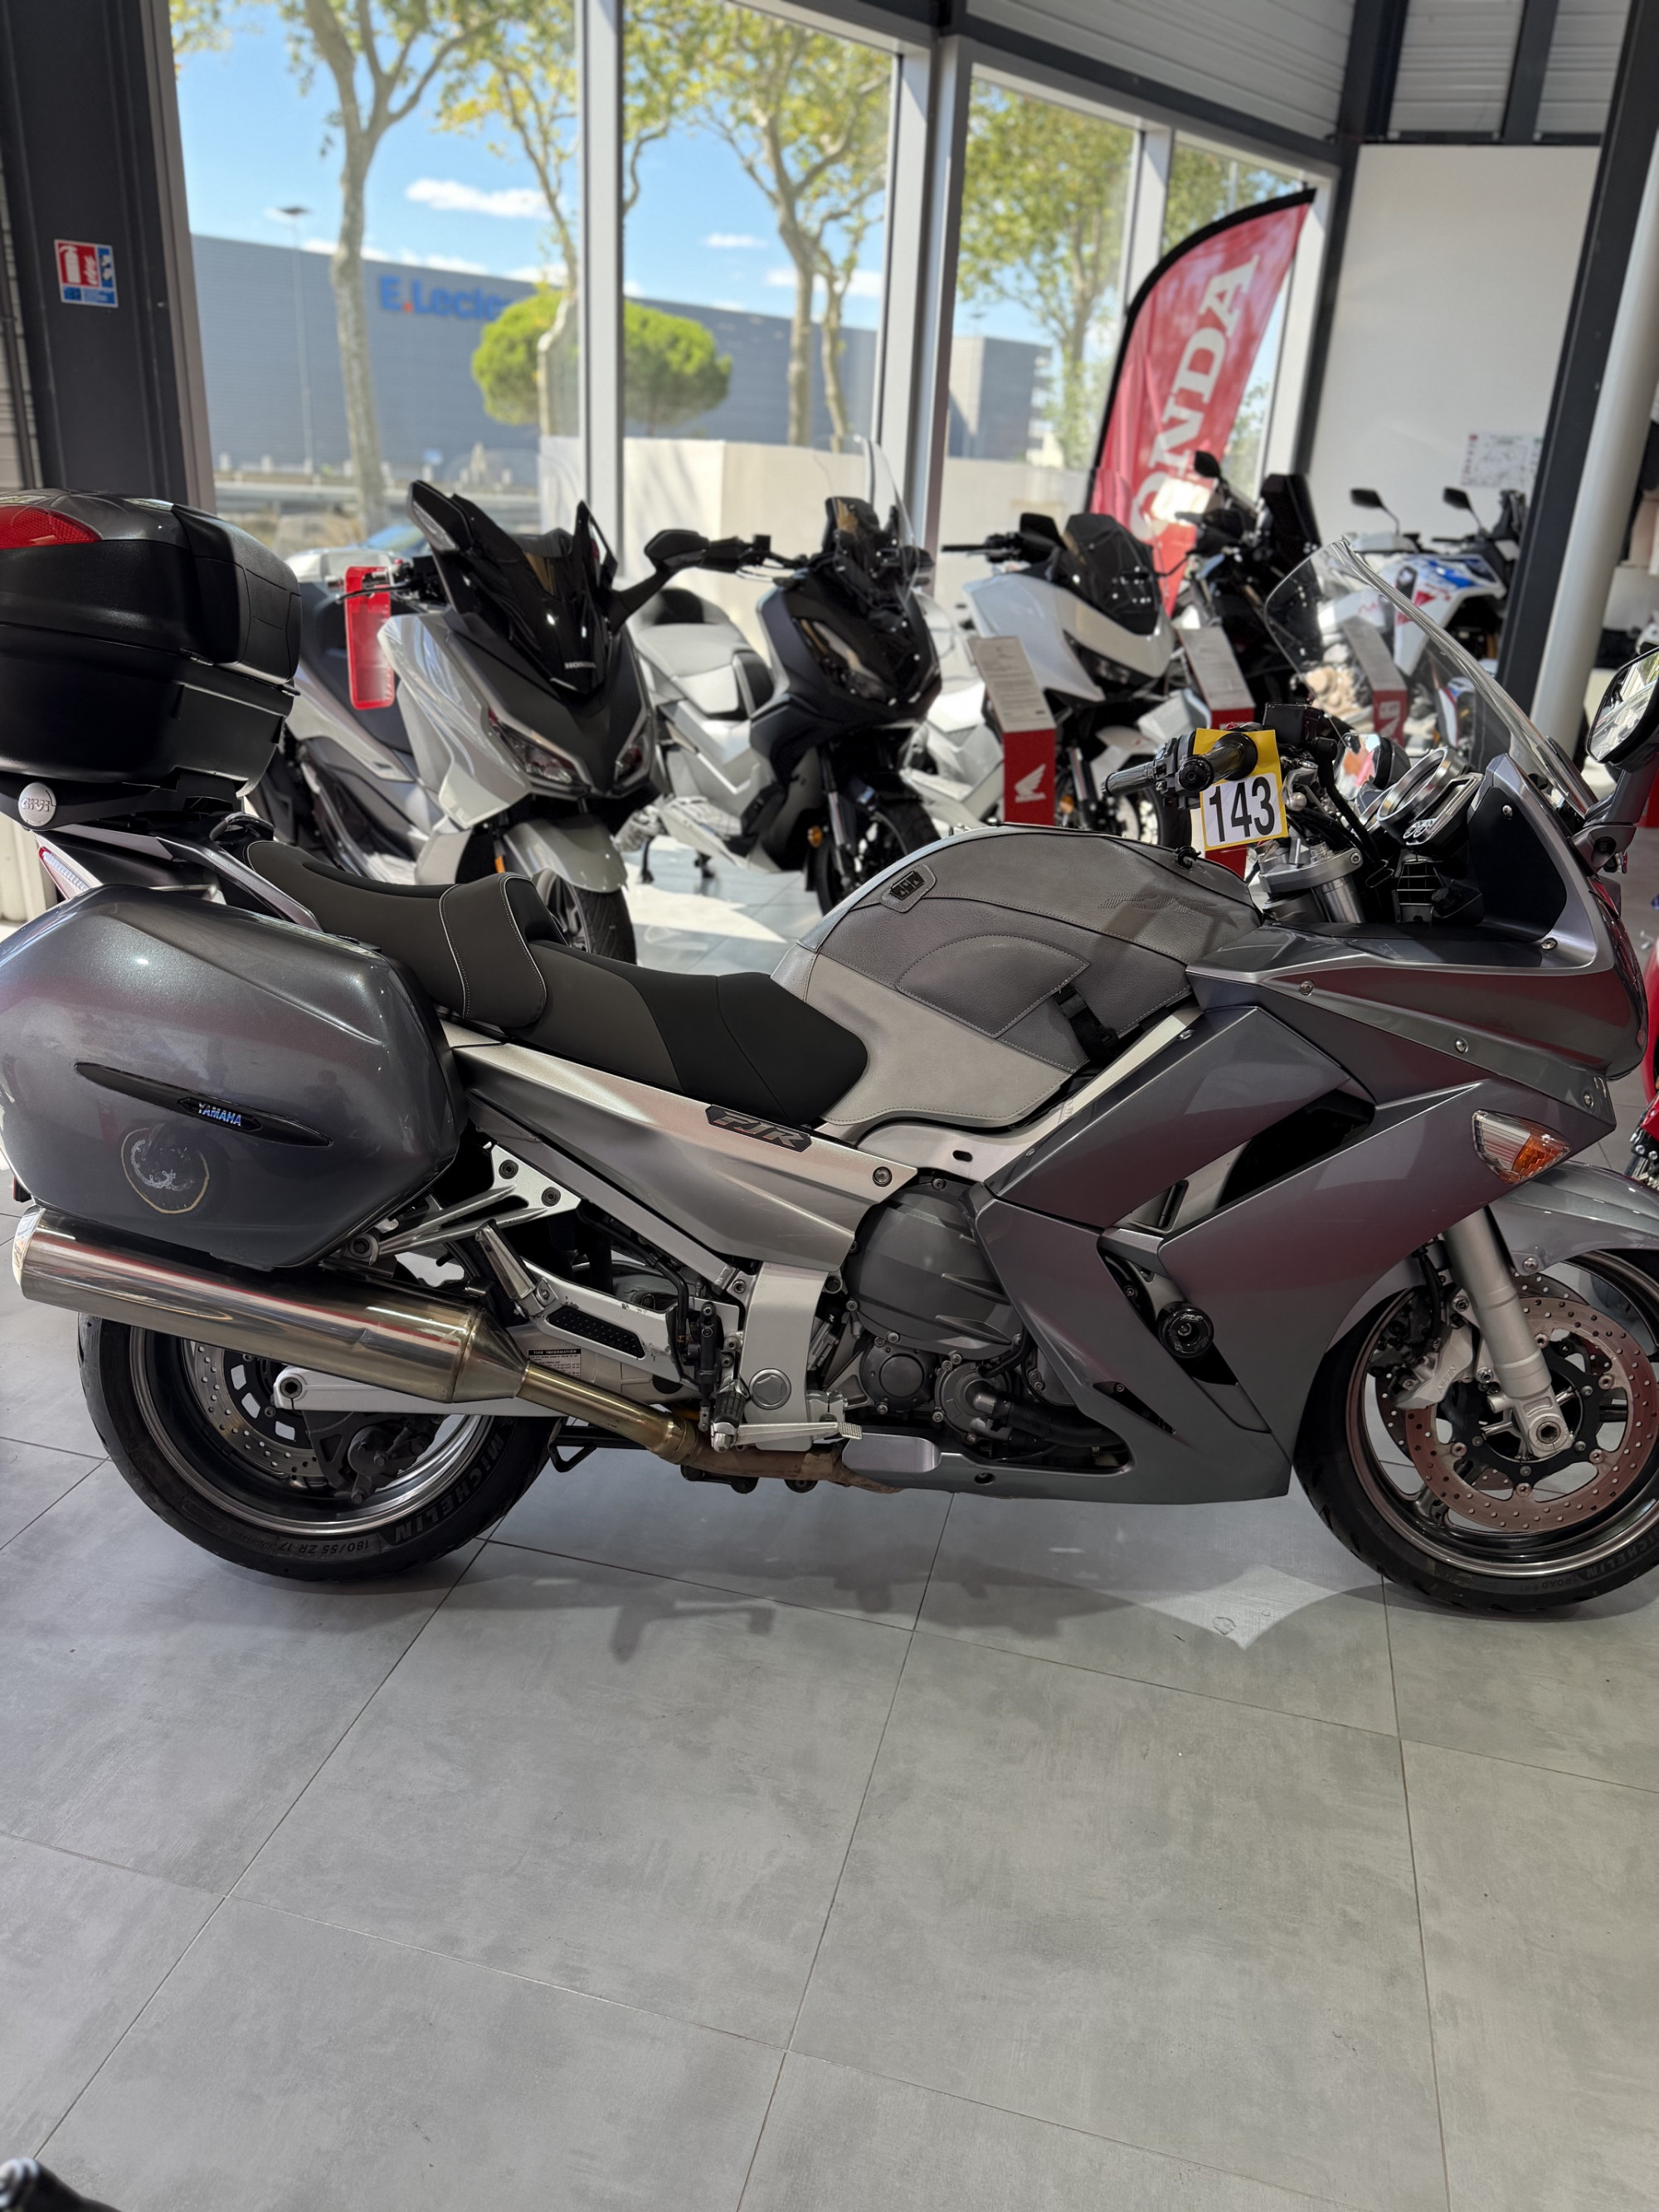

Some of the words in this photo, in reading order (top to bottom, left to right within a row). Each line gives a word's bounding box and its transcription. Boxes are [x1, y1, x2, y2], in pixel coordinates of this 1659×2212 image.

[379, 275, 516, 323] E.Lecle
[1129, 254, 1259, 542] ONDA
[21, 798, 50, 812] GIVI
[1209, 776, 1275, 842] 143
[198, 1102, 241, 1126] YAMAHA
[713, 1111, 804, 1148] FJR
[395, 1432, 504, 1543] MICHELIN
[278, 1542, 293, 1552] 17
[298, 1544, 317, 1554] ZR
[322, 1540, 369, 1554] 180/55
[1541, 1578, 1572, 1588] ROAD
